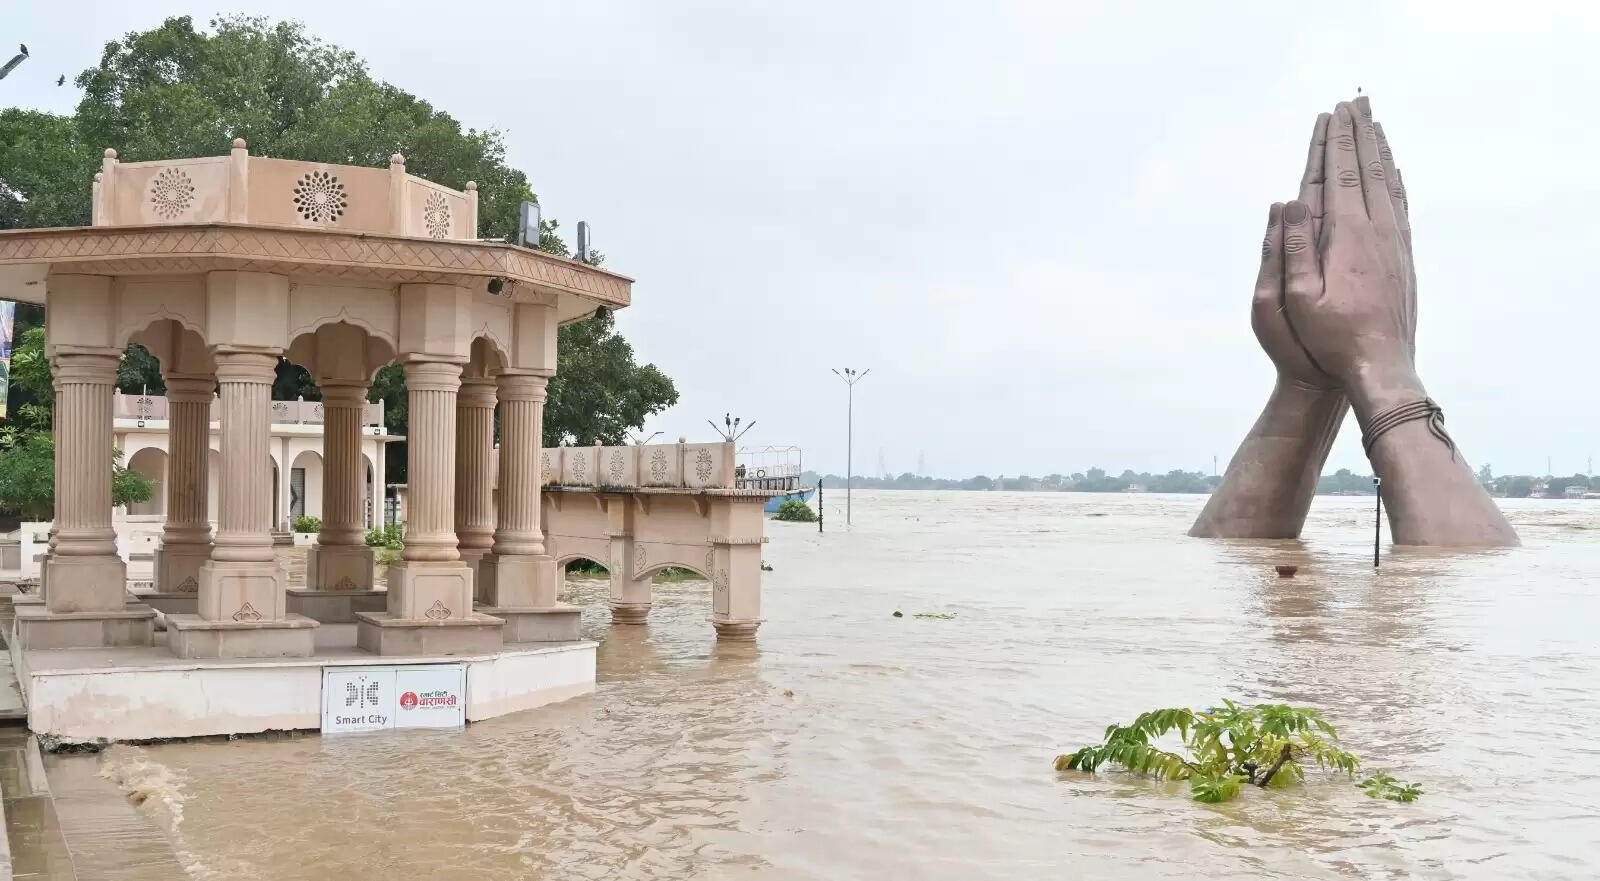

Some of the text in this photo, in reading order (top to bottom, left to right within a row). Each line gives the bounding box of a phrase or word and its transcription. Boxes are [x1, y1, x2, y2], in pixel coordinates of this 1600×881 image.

[419, 694, 457, 706] वाराणसी
[335, 714, 388, 726] Smart City
